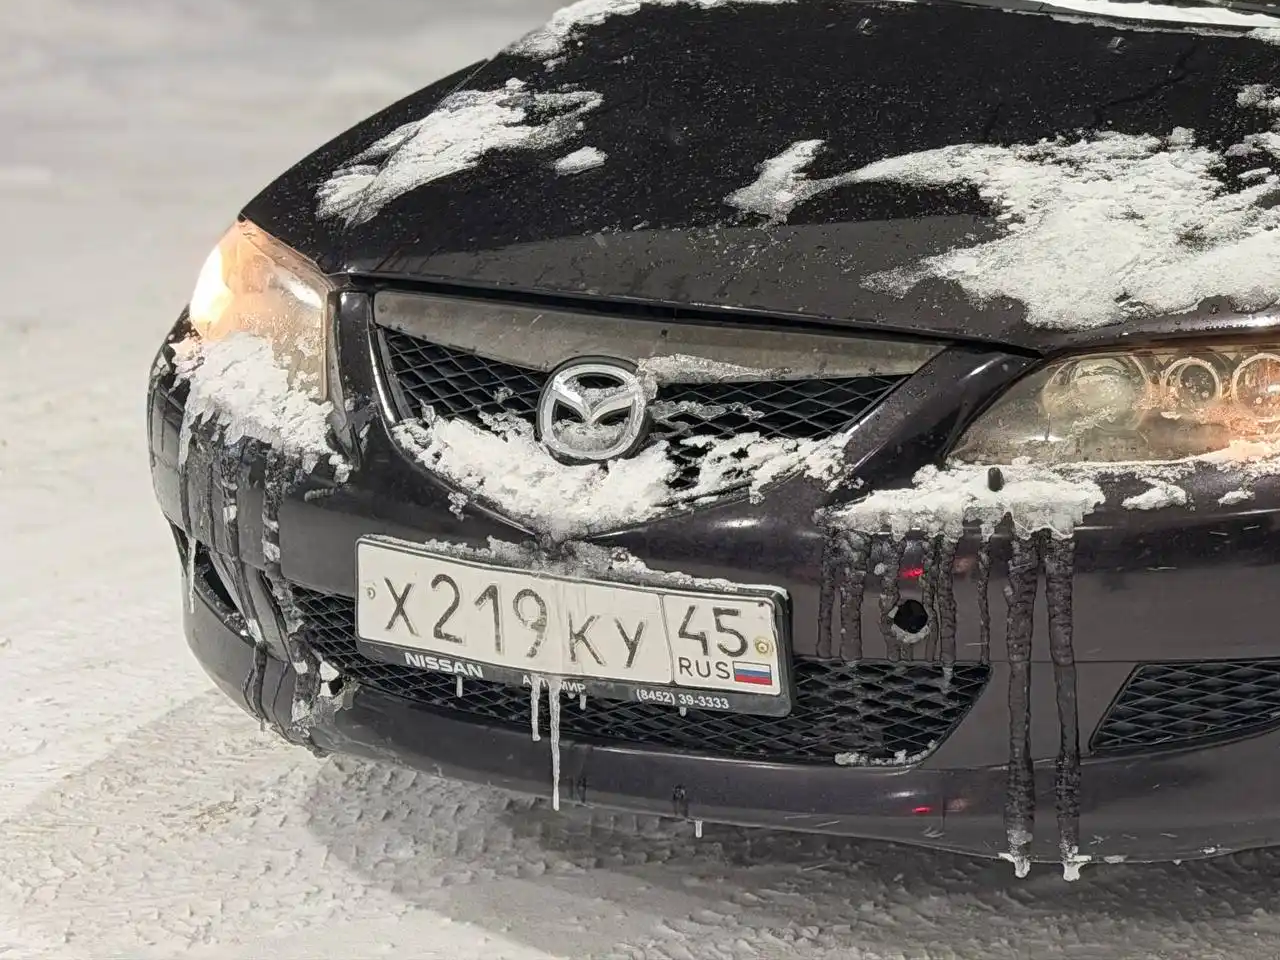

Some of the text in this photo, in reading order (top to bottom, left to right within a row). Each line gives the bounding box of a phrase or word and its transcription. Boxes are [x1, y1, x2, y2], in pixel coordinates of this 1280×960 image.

[677, 604, 749, 658] 45
[404, 652, 484, 679] NISSAN
[678, 656, 731, 680] RUS
[522, 674, 587, 693] АТМИР
[636, 688, 730, 710] (8452) 39-3333
